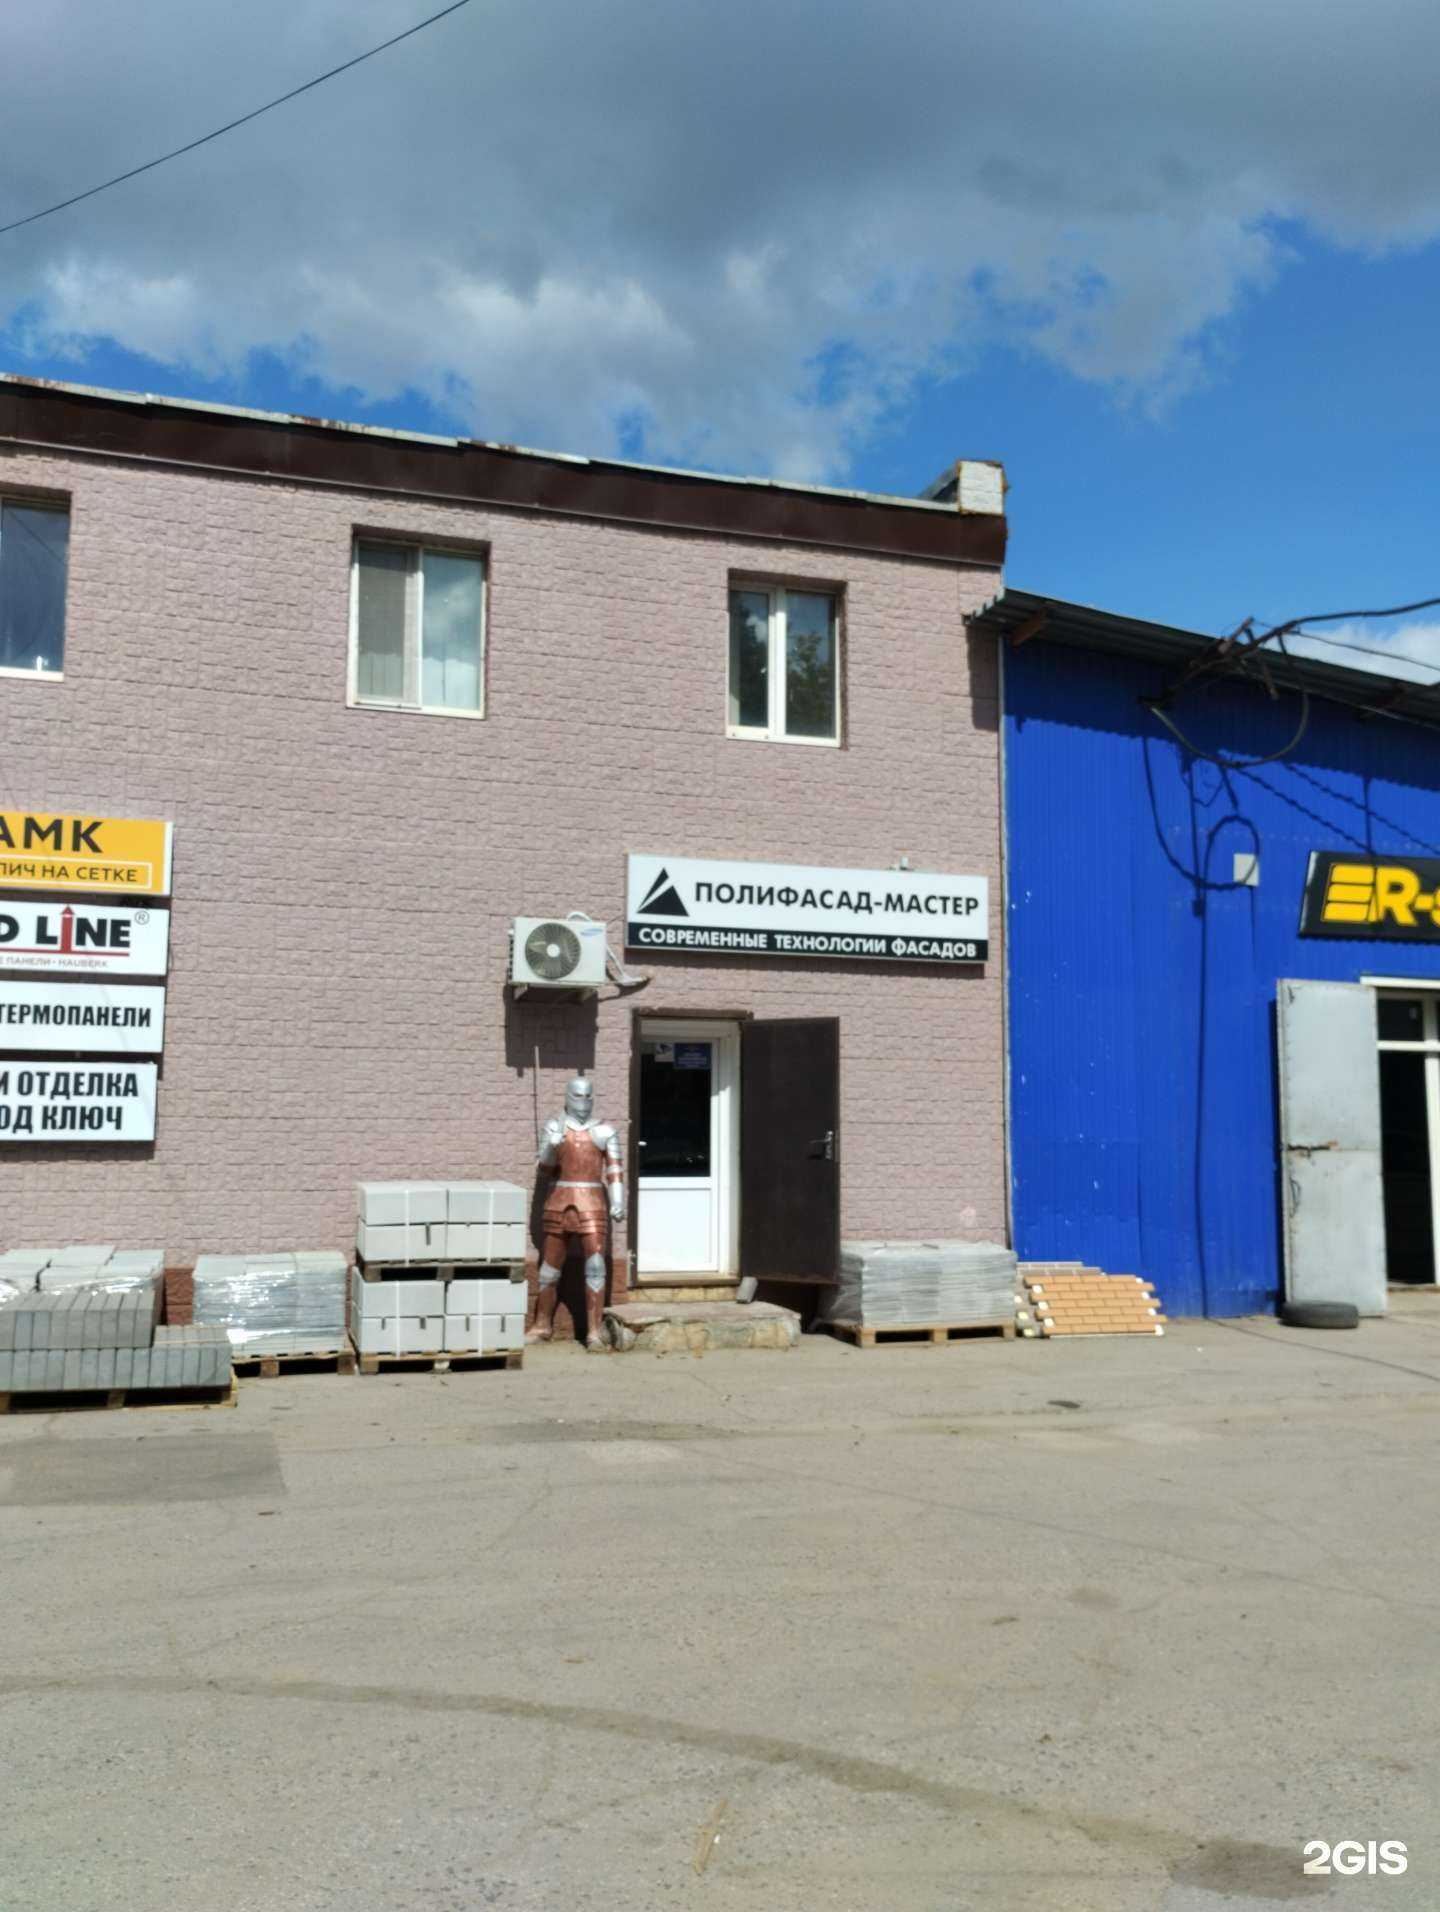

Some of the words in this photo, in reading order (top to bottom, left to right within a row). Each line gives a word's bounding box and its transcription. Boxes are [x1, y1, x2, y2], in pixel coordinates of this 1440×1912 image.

[42, 865, 70, 879] НА
[76, 866, 138, 882] СЕТКЕ
[695, 881, 980, 916] ПОЛИФАСАД-МАСТЕР
[638, 927, 768, 949] СОВРЕМЕННЫЕ
[774, 934, 887, 954] ТЕХНОЛОГИИ
[891, 937, 977, 958] ФАСАДОВ
[17, 1070, 138, 1100] ОТДЕЛКА
[41, 1105, 123, 1131] КЛЮЧ
